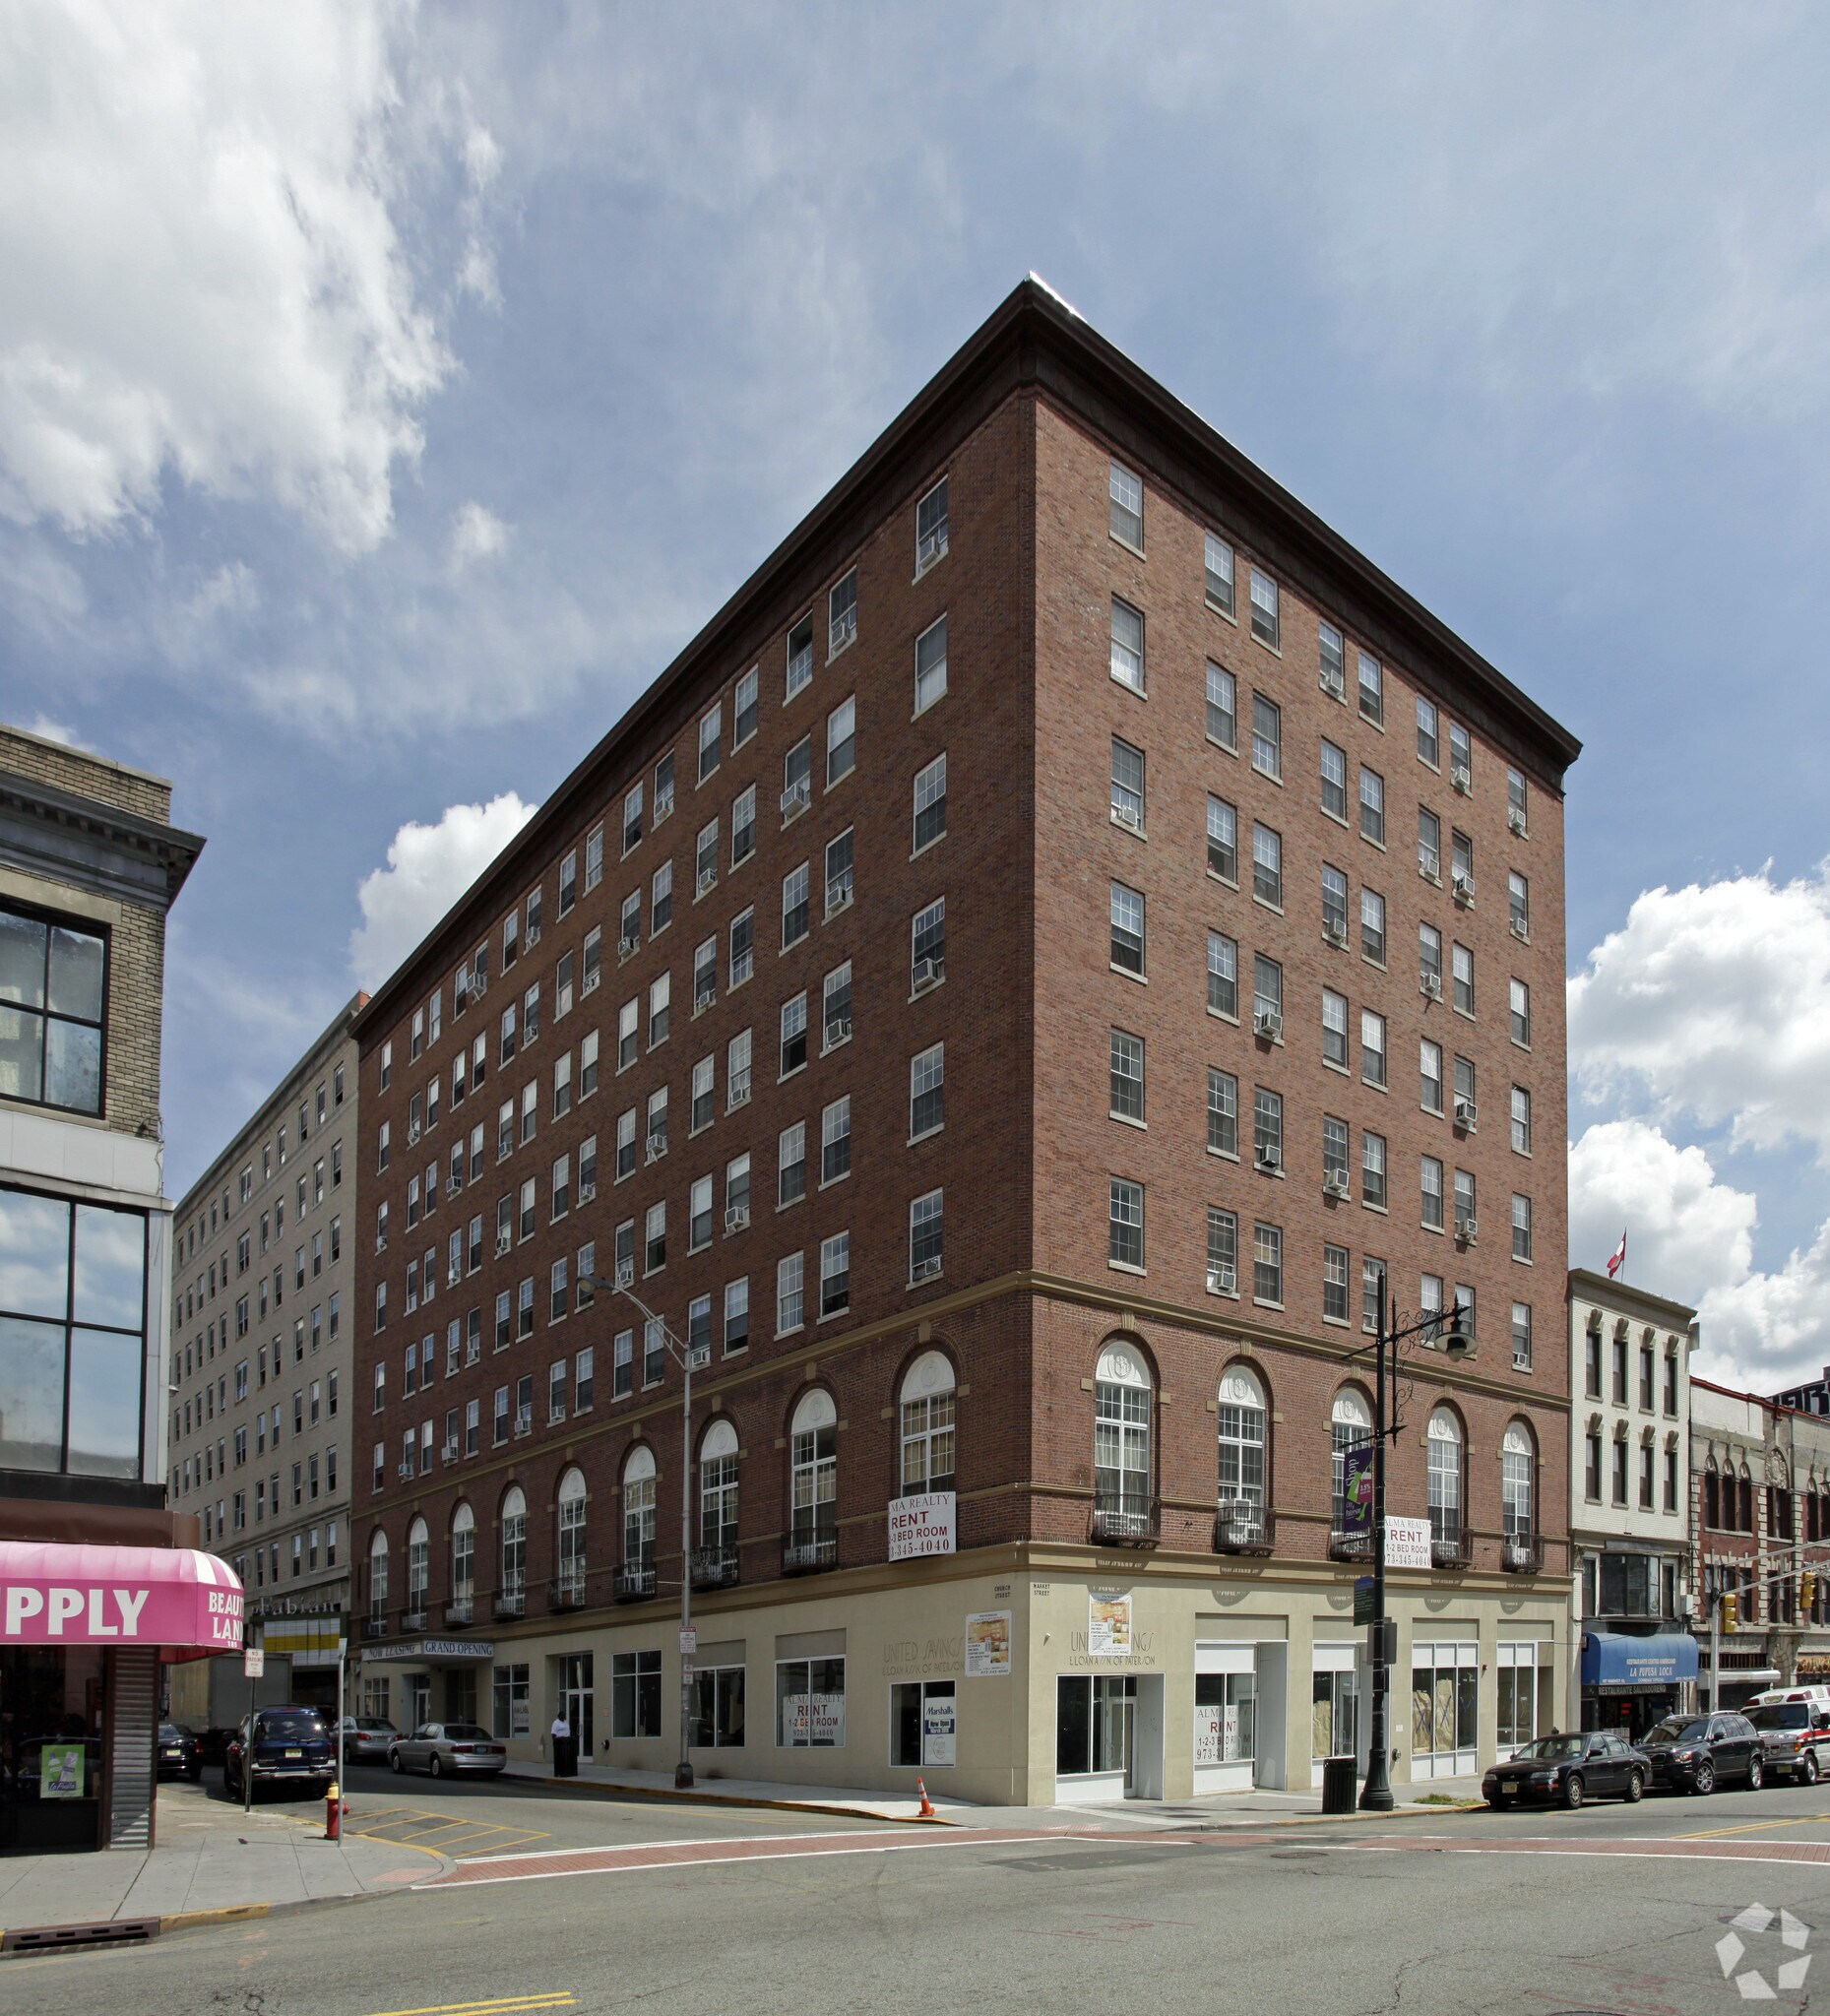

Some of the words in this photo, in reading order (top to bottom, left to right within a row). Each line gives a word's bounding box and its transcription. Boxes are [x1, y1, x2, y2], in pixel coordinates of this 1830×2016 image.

[891, 1501, 906, 1512] MA
[910, 1494, 950, 1508] REALTY
[891, 1511, 929, 1530] RENT
[1408, 1520, 1429, 1529] REALTY
[897, 1530, 914, 1542] BED
[915, 1526, 948, 1538] ROOM
[1390, 1529, 1422, 1543] RENT
[1387, 1553, 1431, 1566] 73-345-4040
[0, 1587, 150, 1635] PPLY
[260, 1597, 335, 1615] Fabian
[369, 1648, 383, 1659] NOW
[386, 1645, 415, 1657] LEASING
[425, 1641, 456, 1654] GRAND
[458, 1643, 492, 1655] OPENING
[882, 1642, 918, 1663] UNITED
[1113, 1656, 1122, 1666] OF
[922, 1663, 932, 1673] OF
[1630, 1668, 1637, 1677] LA
[1660, 1667, 1672, 1675] LOCA
[1599, 1686, 1632, 1695] RESTAURANTE
[788, 1695, 809, 1704] ALM
[926, 1706, 954, 1716] Marshalls
[1197, 1709, 1222, 1718] ALM
[816, 1717, 838, 1726] ROOM
[1198, 1736, 1216, 1746] 1-2-3
